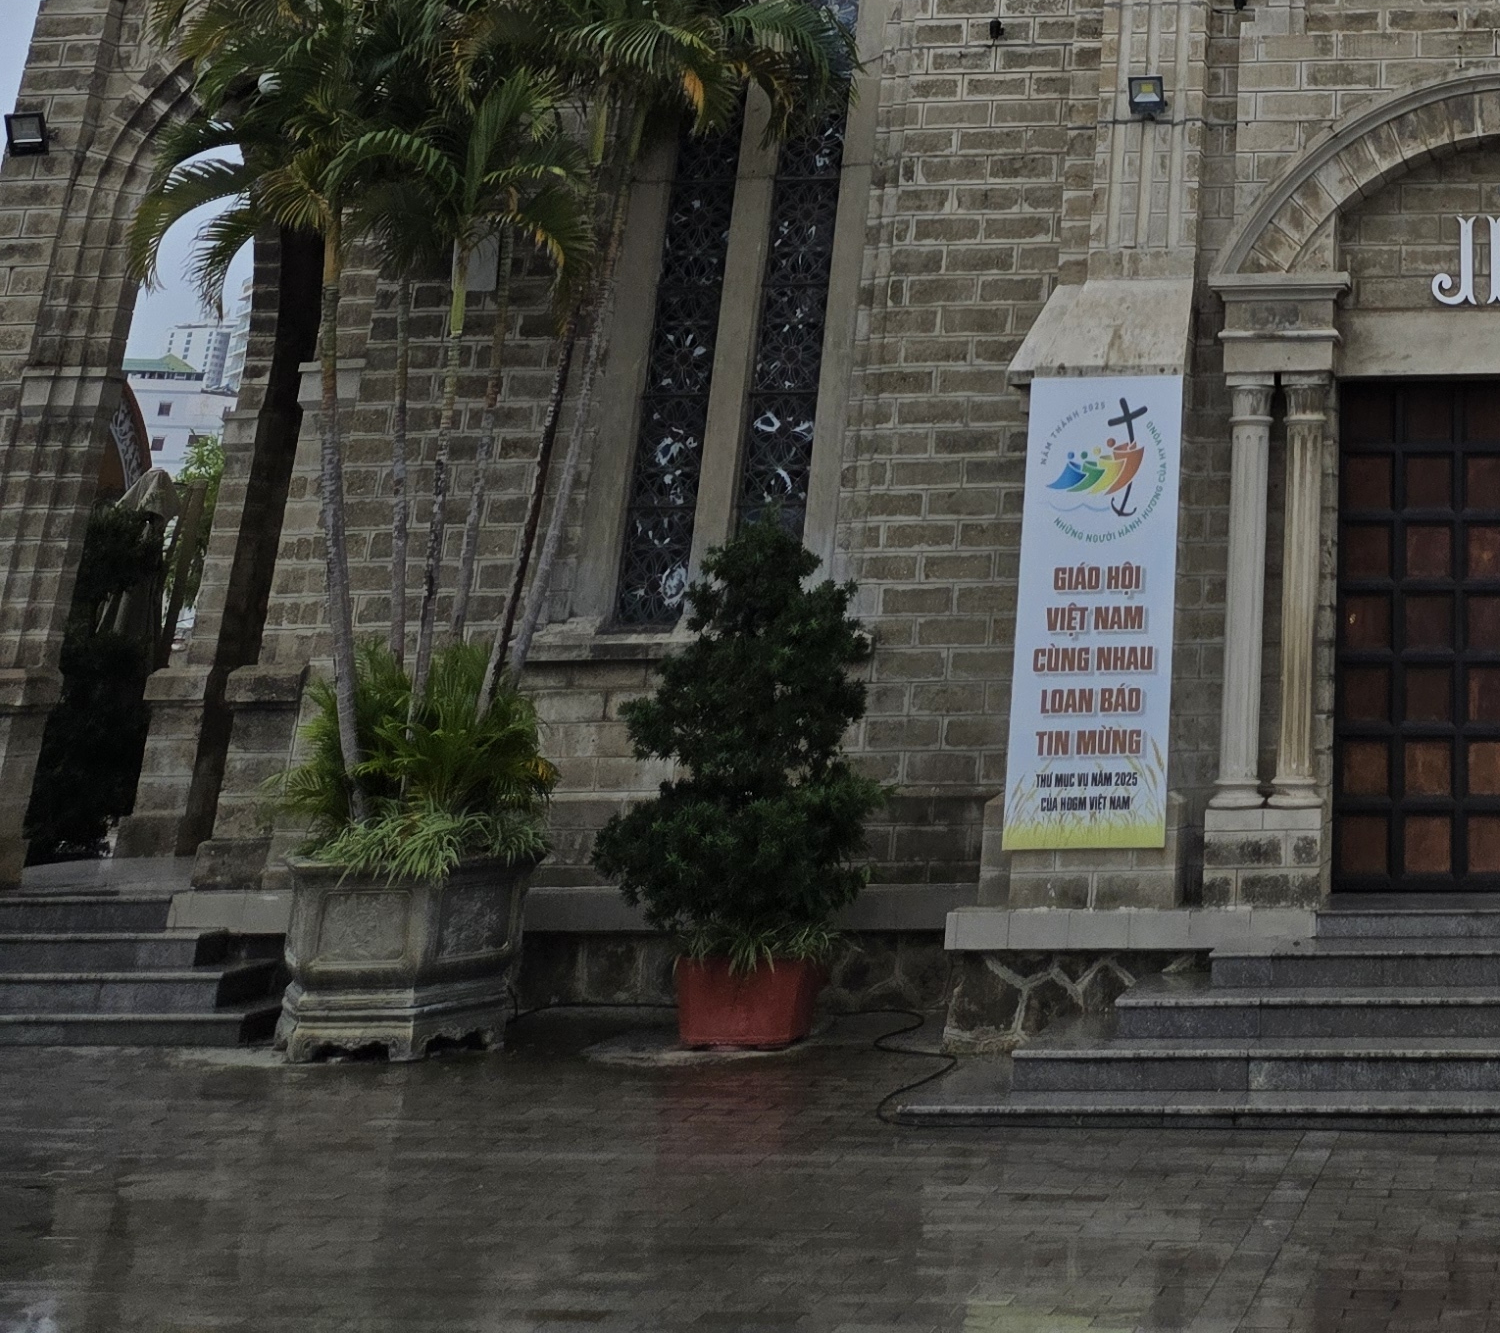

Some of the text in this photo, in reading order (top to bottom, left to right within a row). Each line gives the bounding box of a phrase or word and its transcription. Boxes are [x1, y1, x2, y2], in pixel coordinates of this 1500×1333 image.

[1082, 401, 1105, 414] 2025
[1053, 561, 1141, 595] GIÁO HỘI
[1046, 602, 1144, 637] VIỆT NAM
[1033, 643, 1153, 672] CÙNG NHAU
[1040, 682, 1142, 714] LOAN BÁO
[1036, 725, 1142, 756] TIN MỪNG
[1054, 773, 1075, 791] MỤC
[1077, 773, 1089, 790] VỤ
[1114, 772, 1138, 787] 2025
[1109, 796, 1131, 810] NAM
